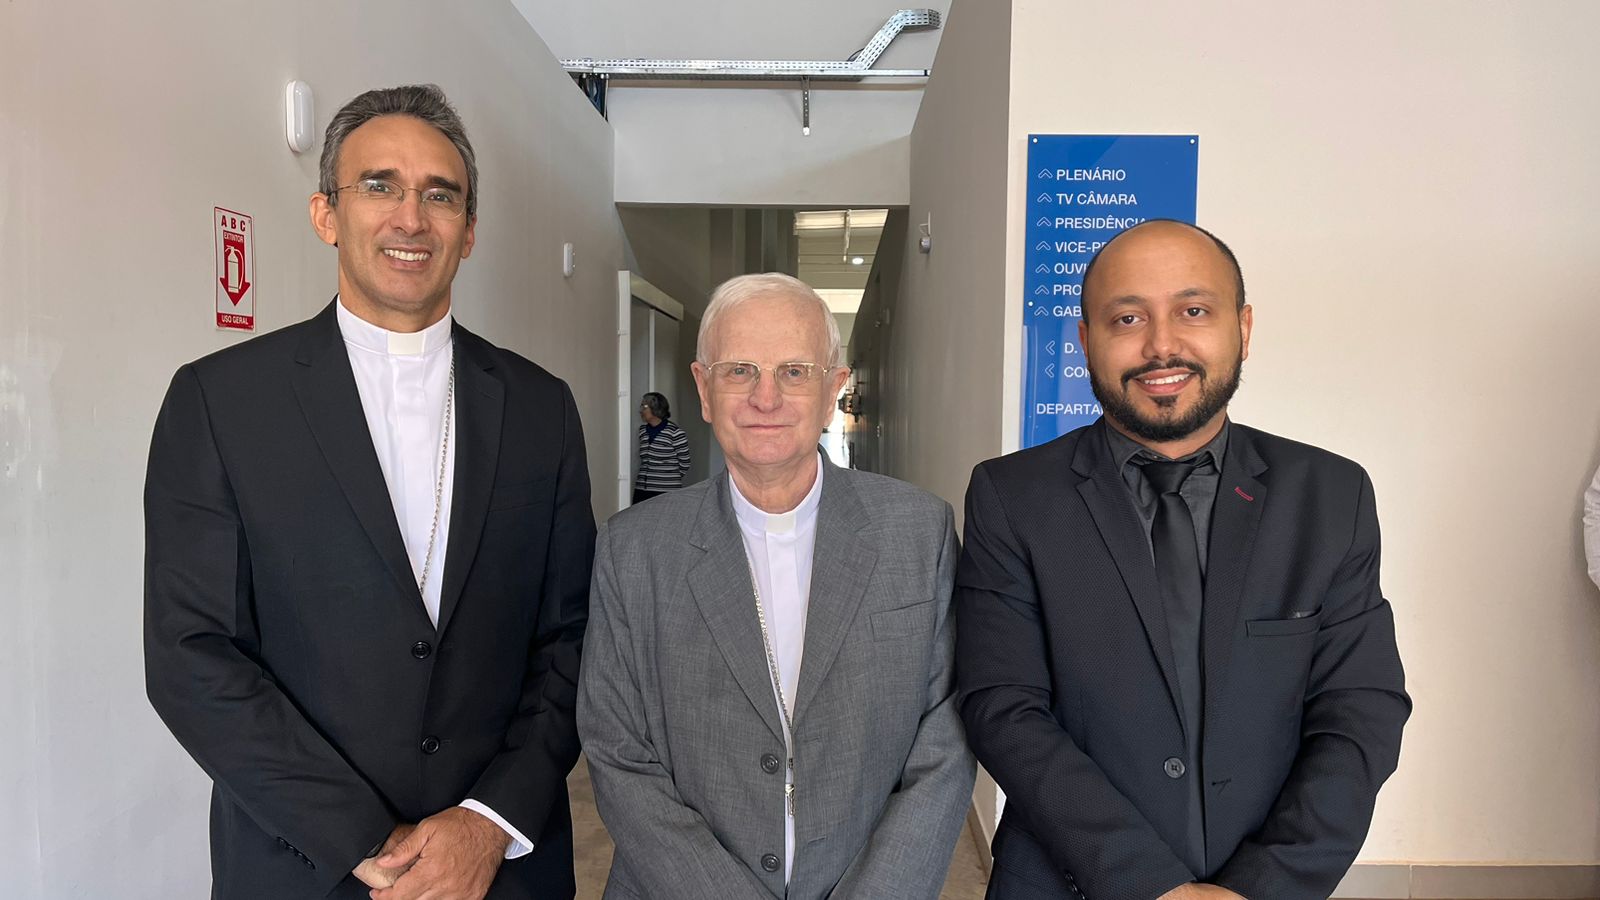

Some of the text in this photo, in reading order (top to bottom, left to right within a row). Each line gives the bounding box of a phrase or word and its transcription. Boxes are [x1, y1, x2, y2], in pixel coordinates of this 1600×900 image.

[1056, 167, 1126, 181] PLENÁRIO
[1056, 191, 1138, 205] TV CÂMARA
[1054, 263, 1090, 274] OUVI
[222, 315, 248, 325] USO GERAL
[1064, 342, 1078, 354] D.
